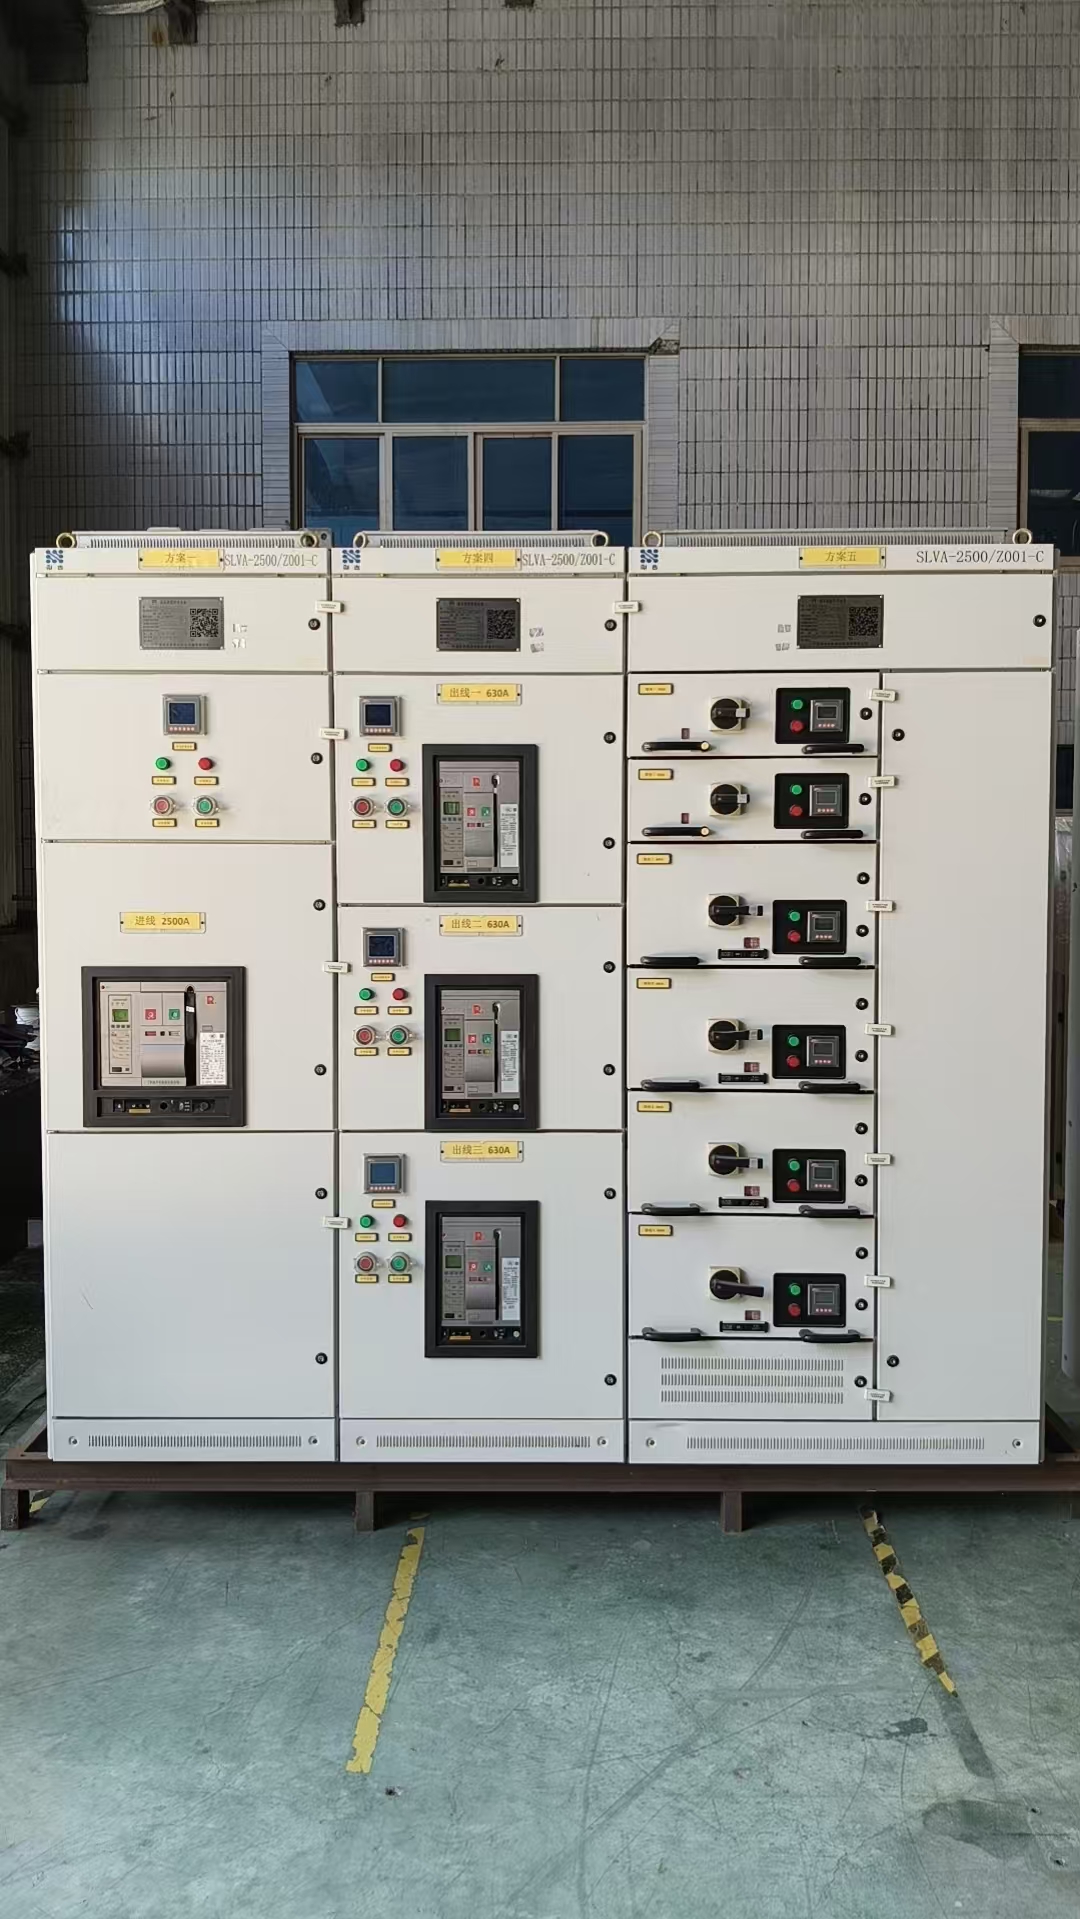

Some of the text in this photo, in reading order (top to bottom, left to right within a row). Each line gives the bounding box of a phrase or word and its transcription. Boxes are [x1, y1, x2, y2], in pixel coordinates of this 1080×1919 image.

[224, 554, 318, 567] SLVA-2500/Z001-C
[462, 552, 494, 564] 方案四
[522, 553, 616, 566] SLVA-2500/Z001-C
[824, 551, 857, 562] 方案五
[916, 551, 1044, 563] SLVA-2500/Z001-C
[449, 687, 509, 698] 出线一 630A
[135, 915, 190, 926] 进线 2500A
[451, 918, 510, 929] 出线二 630A
[452, 1144, 511, 1155] 出线三 630A
